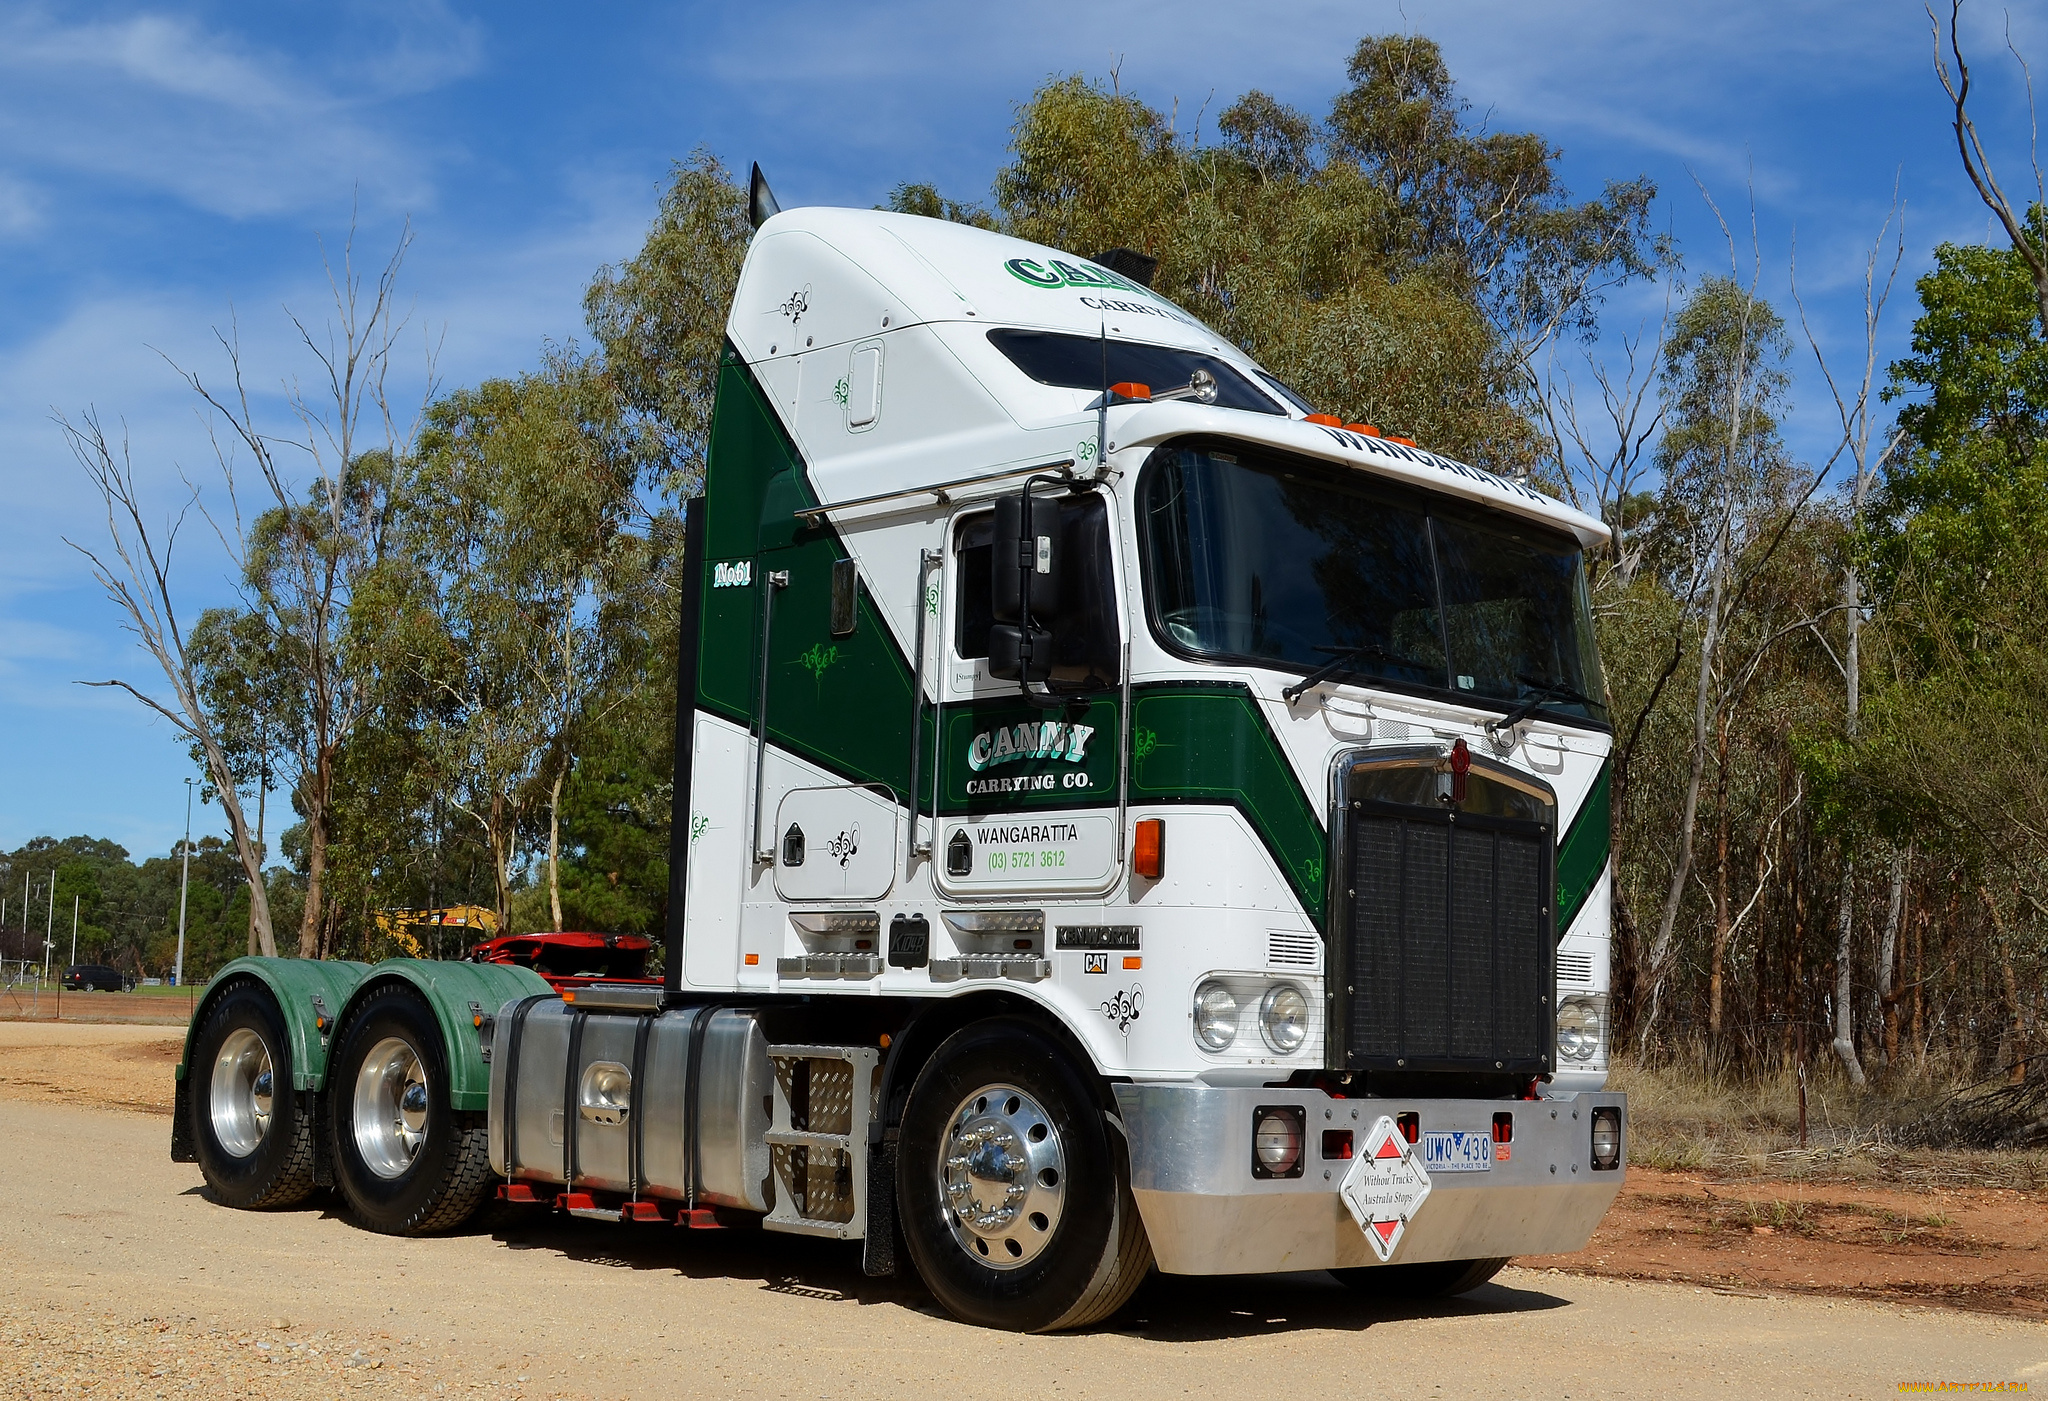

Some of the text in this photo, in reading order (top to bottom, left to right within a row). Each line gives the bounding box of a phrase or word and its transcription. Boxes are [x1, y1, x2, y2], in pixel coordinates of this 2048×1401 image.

[1317, 426, 1548, 505] WANGARATTA
[968, 720, 1095, 772] CANNY
[966, 772, 1094, 795] CARRYING CO.
[977, 823, 1078, 844] WANGARATTA
[988, 850, 1066, 873] (03) 5721 3612
[1056, 926, 1140, 945] KENWORTH
[1086, 954, 1107, 973] CAT
[1426, 1137, 1452, 1161] UWQ
[1463, 1137, 1489, 1161] 438
[1391, 1172, 1414, 1185] Trucks
[1394, 1191, 1413, 1206] Stops
